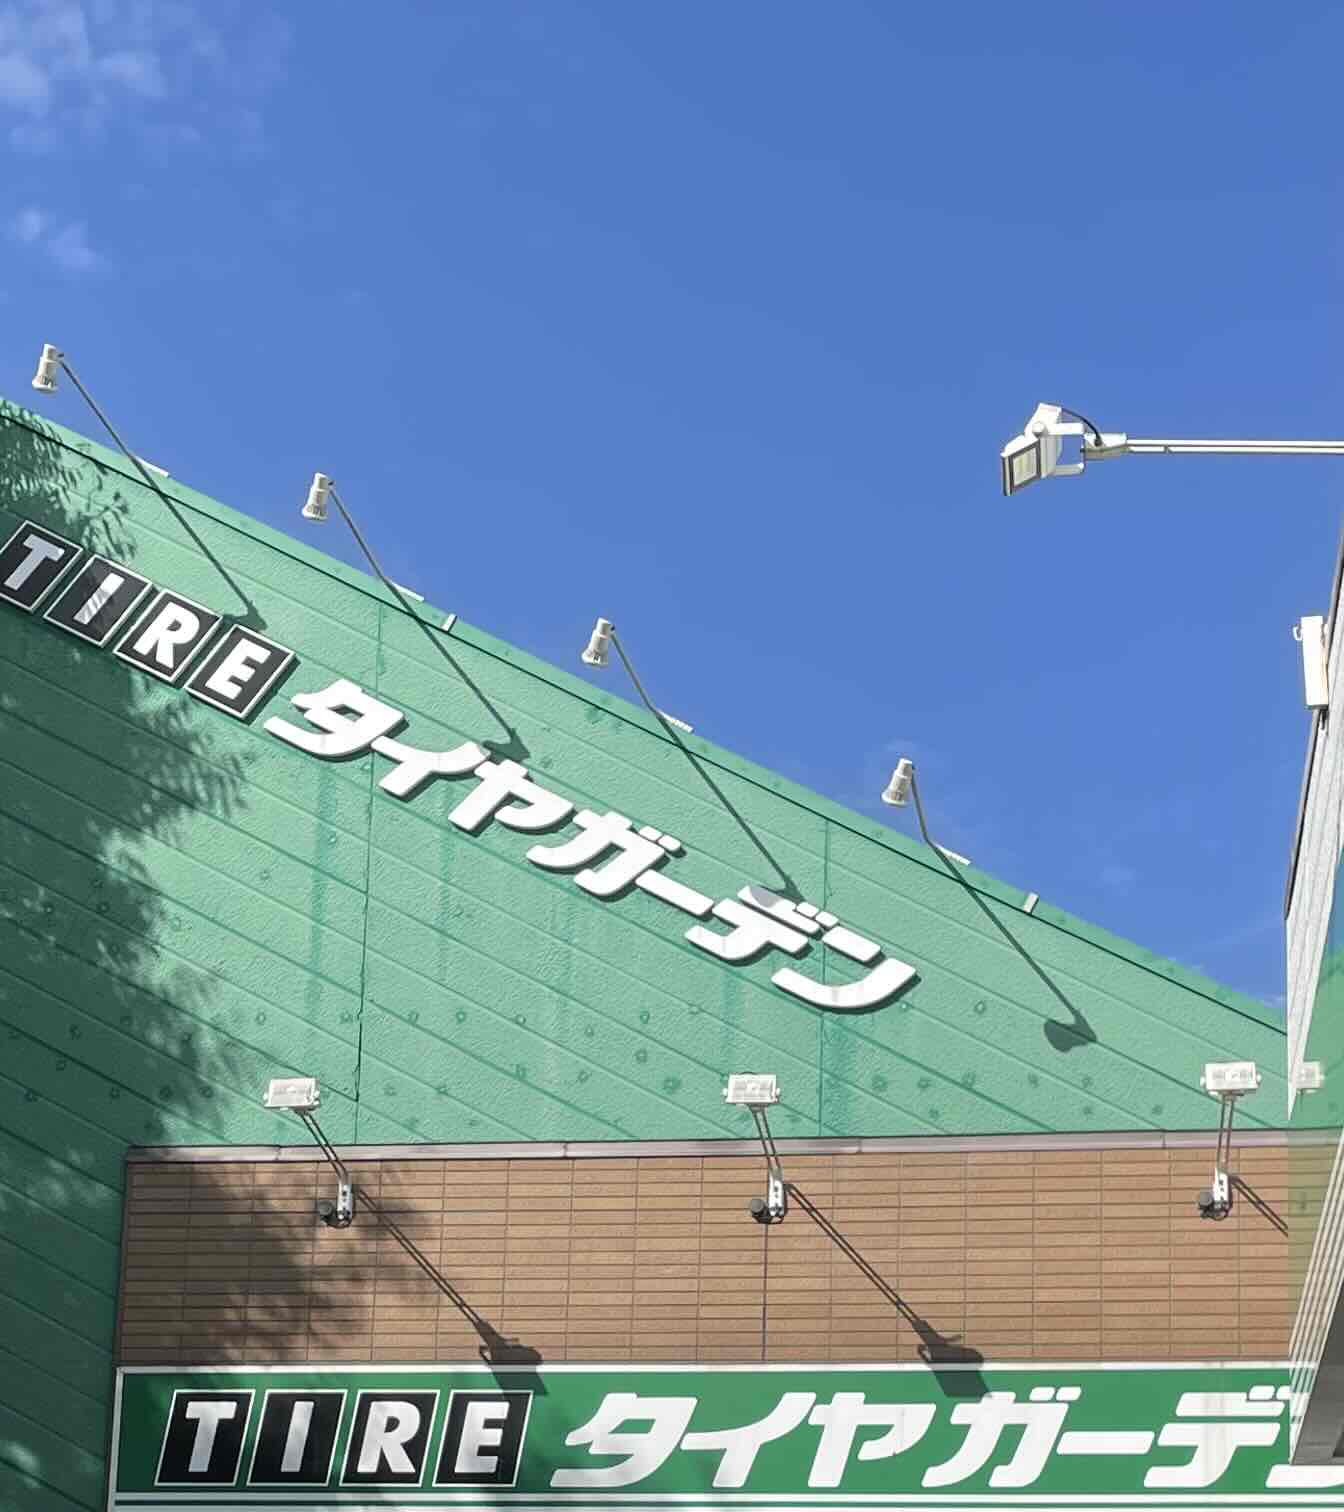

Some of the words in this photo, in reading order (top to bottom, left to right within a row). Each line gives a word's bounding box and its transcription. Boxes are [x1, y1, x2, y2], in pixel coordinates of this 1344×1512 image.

[263, 677, 917, 1008] タイヤガーデン
[184, 1401, 510, 1475] TIRE
